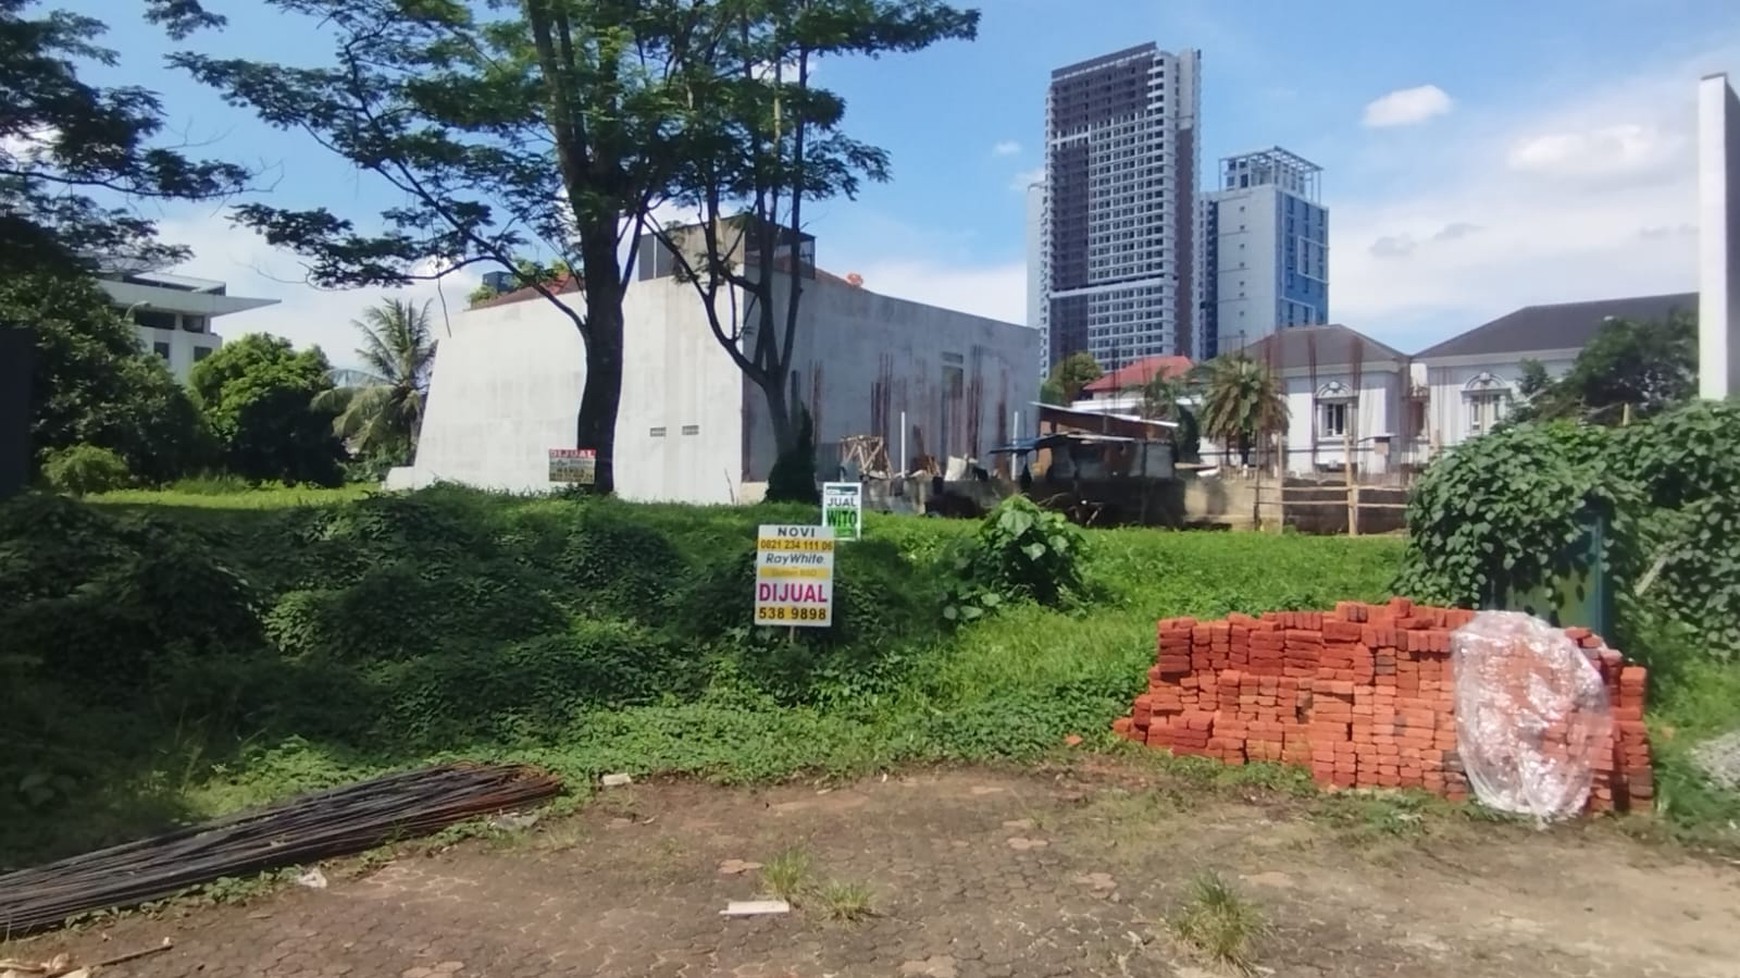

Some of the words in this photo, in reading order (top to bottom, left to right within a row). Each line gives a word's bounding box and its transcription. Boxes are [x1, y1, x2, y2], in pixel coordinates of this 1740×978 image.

[827, 497, 857, 507] JUAL
[827, 509, 857, 527] WITO
[777, 528, 816, 537] NOVI
[760, 540, 781, 549] 0821
[785, 540, 801, 550] 234
[804, 541, 819, 551] 111
[759, 583, 828, 603] DIJUAL
[759, 607, 785, 620] 538
[791, 608, 827, 621] 9898
